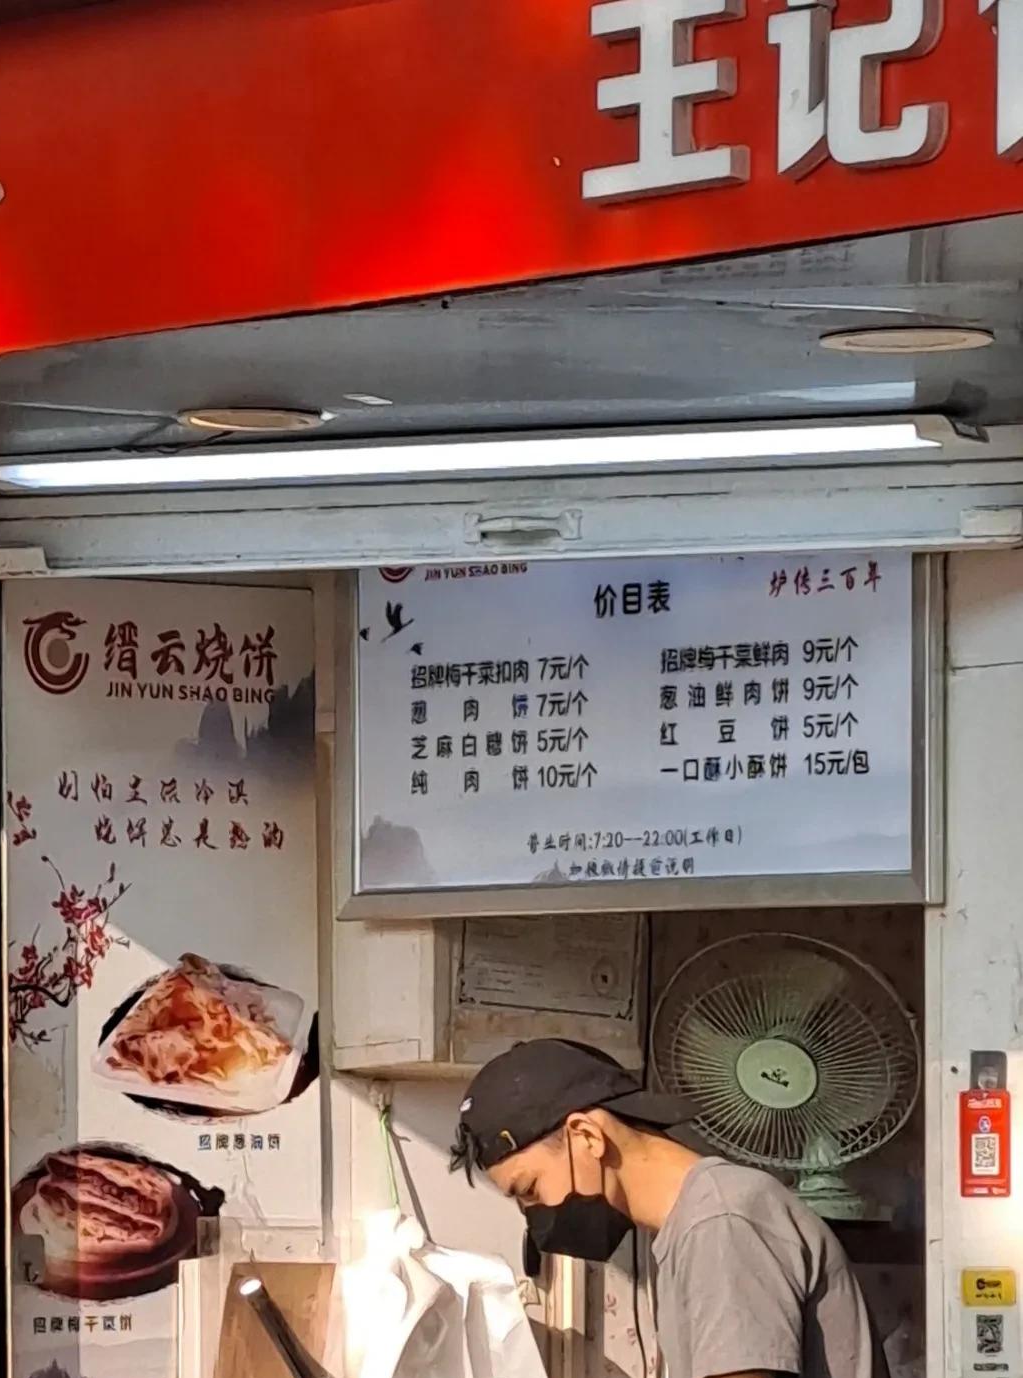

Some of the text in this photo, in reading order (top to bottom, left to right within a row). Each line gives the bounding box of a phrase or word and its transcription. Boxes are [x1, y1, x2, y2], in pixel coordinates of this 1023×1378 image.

[582, 0, 1023, 200] 王记
[425, 567, 442, 581] JIN
[444, 566, 466, 579] YUN
[501, 562, 528, 575] BING
[594, 581, 671, 617] 价目表
[104, 621, 277, 686] 缙云烧饼
[803, 635, 859, 664] 9元/个
[411, 654, 589, 690] 招牌梅干菜扣肉 7元/个
[106, 681, 276, 704] JIN YUN SHAO BING
[536, 690, 589, 717] 7元/个
[660, 673, 859, 710] 葱油鲜肉饼 9元/个
[411, 726, 589, 760] 芝麻白糖饼 5元/个
[660, 711, 859, 746] 红豆饼 5元/个
[411, 761, 598, 795] 纯肉饼 10元/个
[805, 750, 870, 776] 15元/包
